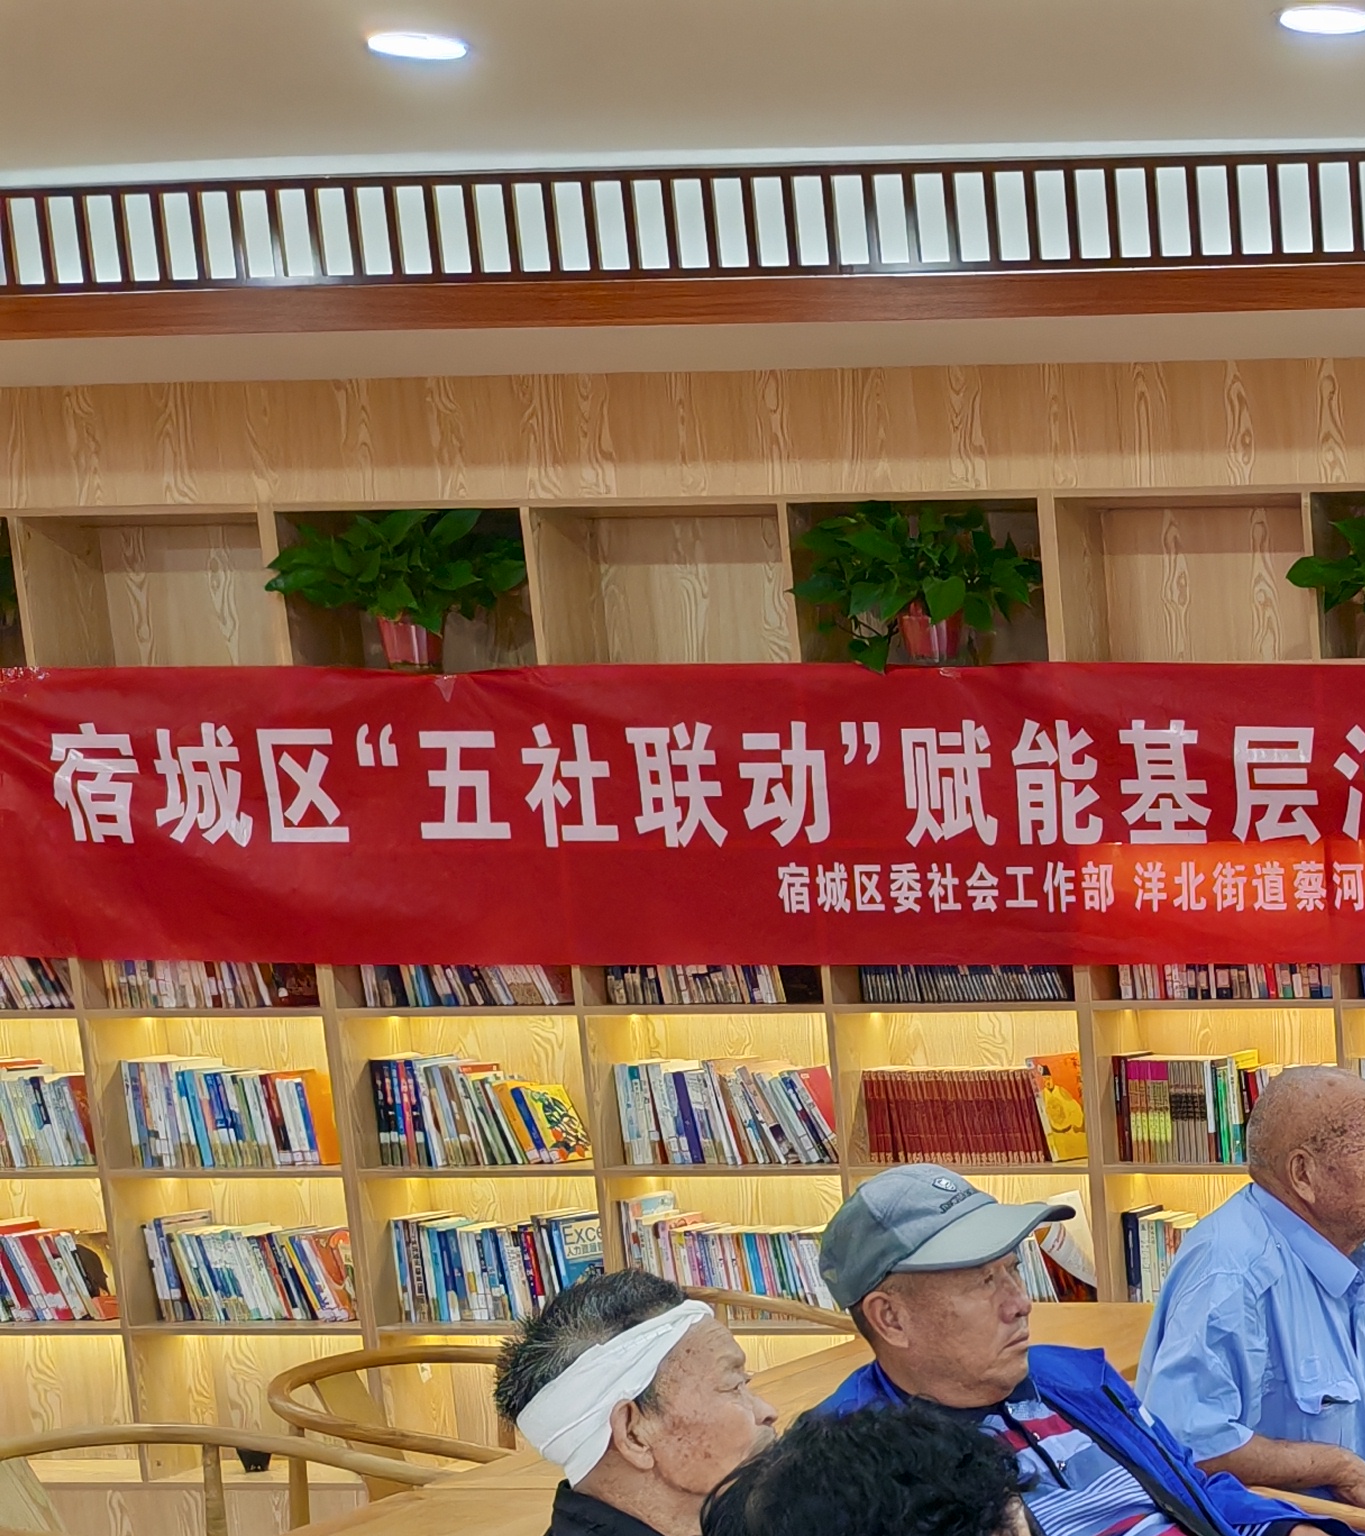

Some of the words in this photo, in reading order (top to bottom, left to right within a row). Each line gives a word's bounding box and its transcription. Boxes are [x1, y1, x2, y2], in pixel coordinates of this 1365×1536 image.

[777, 860, 1115, 914] 宿城区委社会工作部
